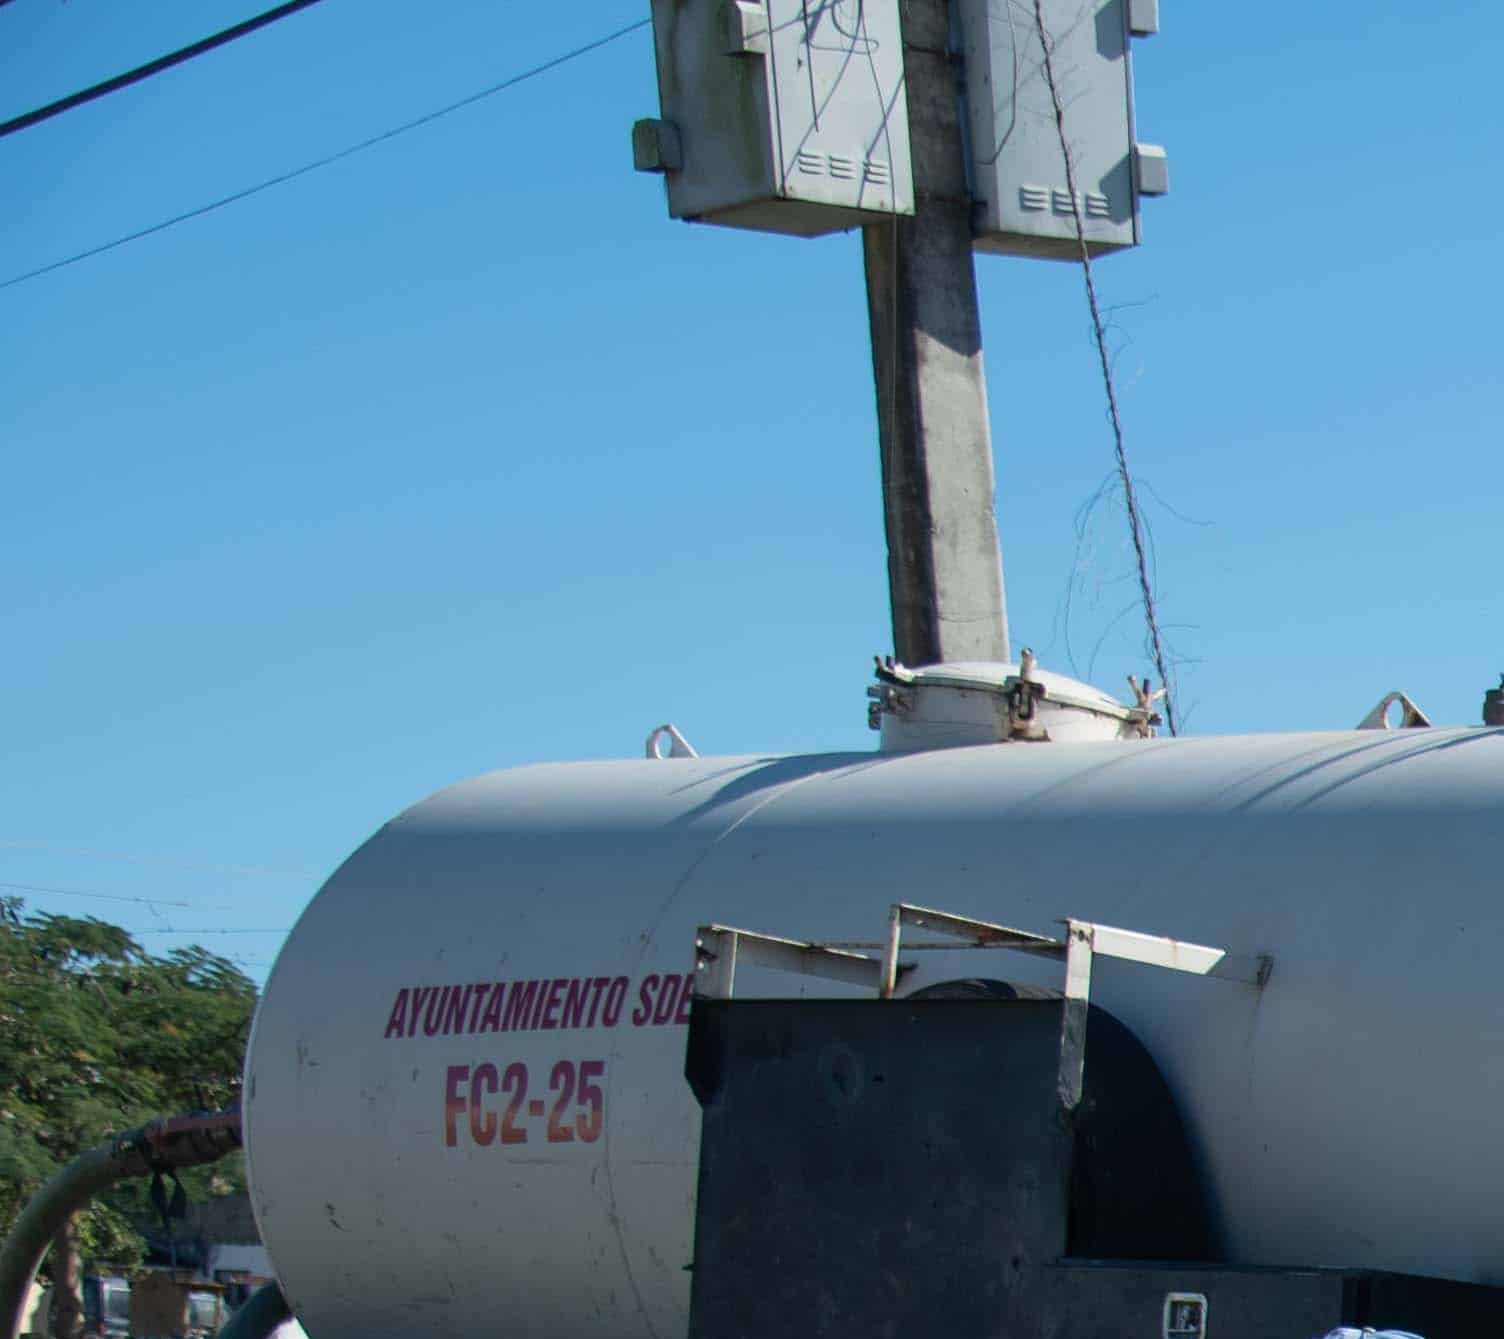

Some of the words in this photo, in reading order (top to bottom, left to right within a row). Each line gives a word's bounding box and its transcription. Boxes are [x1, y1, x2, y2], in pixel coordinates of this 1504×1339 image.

[384, 976, 629, 1039] AYUNTAMIENTO
[631, 973, 696, 1027] SDE
[445, 1060, 606, 1148] FC2-25
